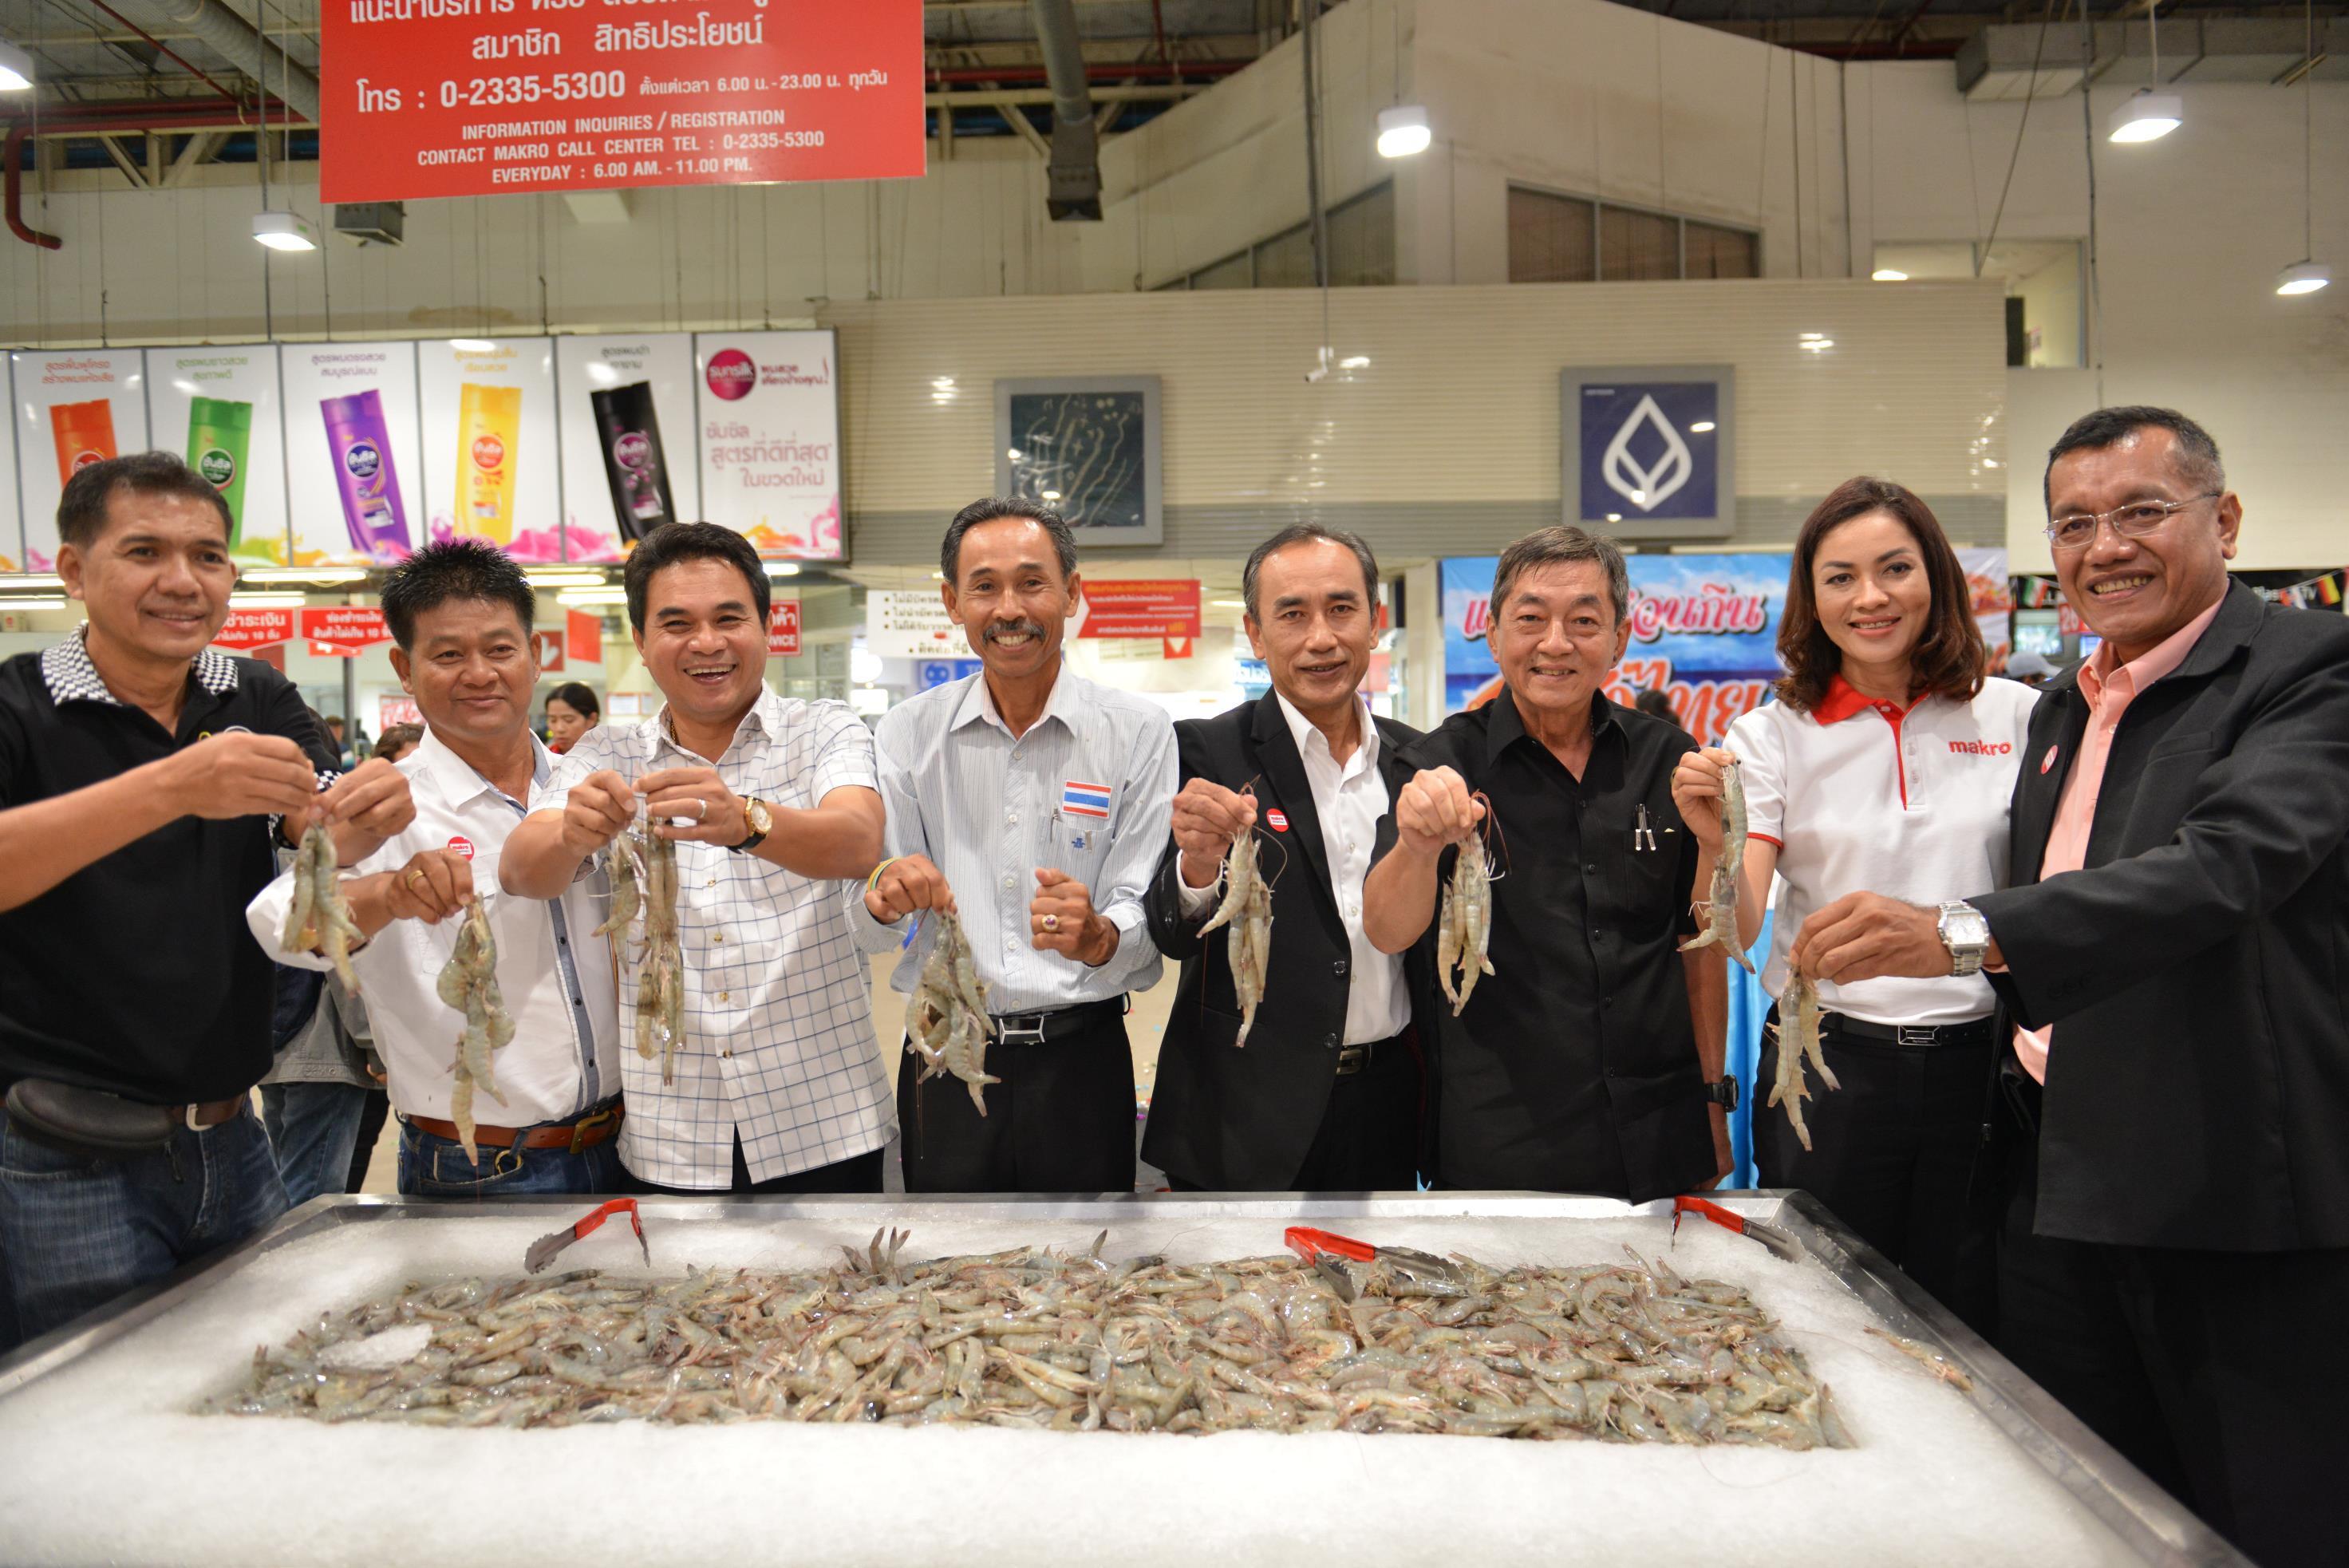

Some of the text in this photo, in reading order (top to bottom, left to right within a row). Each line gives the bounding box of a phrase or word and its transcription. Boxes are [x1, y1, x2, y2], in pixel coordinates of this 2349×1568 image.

[472, 12, 764, 60] สมาชิก สิทธิประโยชน์
[357, 78, 401, 113] โทร
[440, 70, 626, 108] 0-2335-5300
[640, 77, 709, 95] ตั้งแต่เวลา
[717, 77, 750, 92] 6.00
[849, 69, 887, 91] ทุกวัน
[462, 120, 567, 140] INFORMATION
[574, 115, 653, 134] INQUIRIES
[671, 109, 785, 128] REGISTRATION
[417, 147, 486, 166] CONTACT
[494, 143, 549, 161] MAKRO
[558, 141, 596, 157] CALL
[604, 137, 664, 155] CENTER
[673, 136, 701, 152] TEL
[723, 131, 824, 150] 0-2335-5300
[492, 165, 571, 184] EVERYDAY
[594, 162, 628, 178] 6.00
[634, 160, 662, 176] AM.
[724, 157, 752, 172] PM.
[709, 361, 754, 380] sunsilk
[1948, 739, 2012, 756] makro
